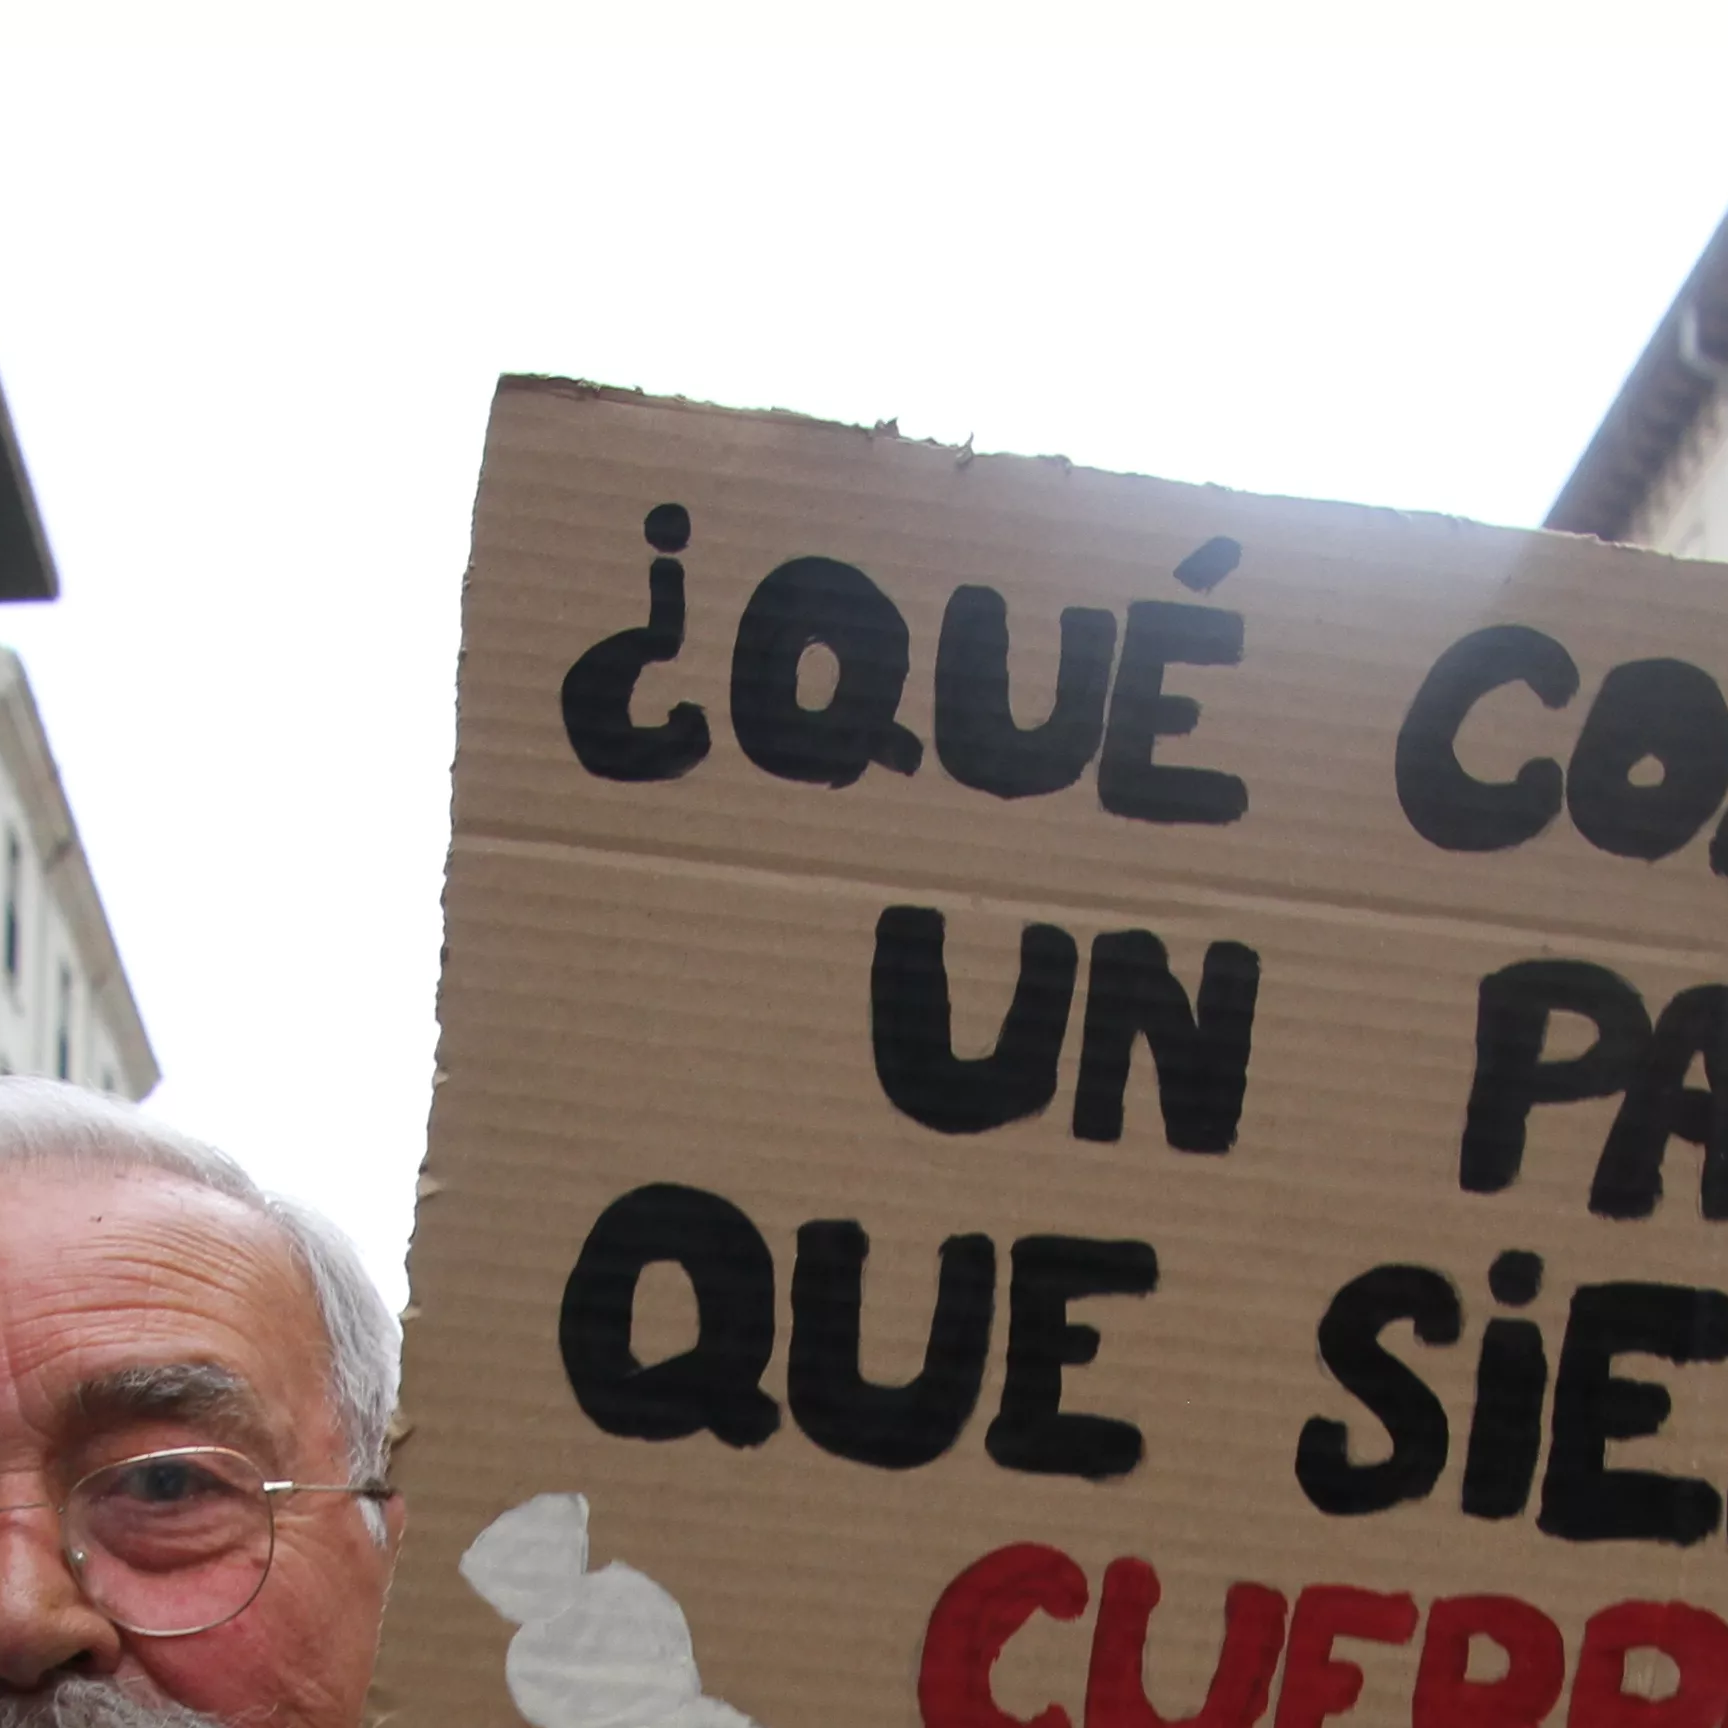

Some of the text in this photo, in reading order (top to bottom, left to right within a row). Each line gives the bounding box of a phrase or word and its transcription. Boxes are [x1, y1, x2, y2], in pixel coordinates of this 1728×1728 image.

[558, 501, 1250, 824] ¿QUÉ
[869, 903, 1262, 1156] UN
[557, 1180, 1161, 1483] QUE
